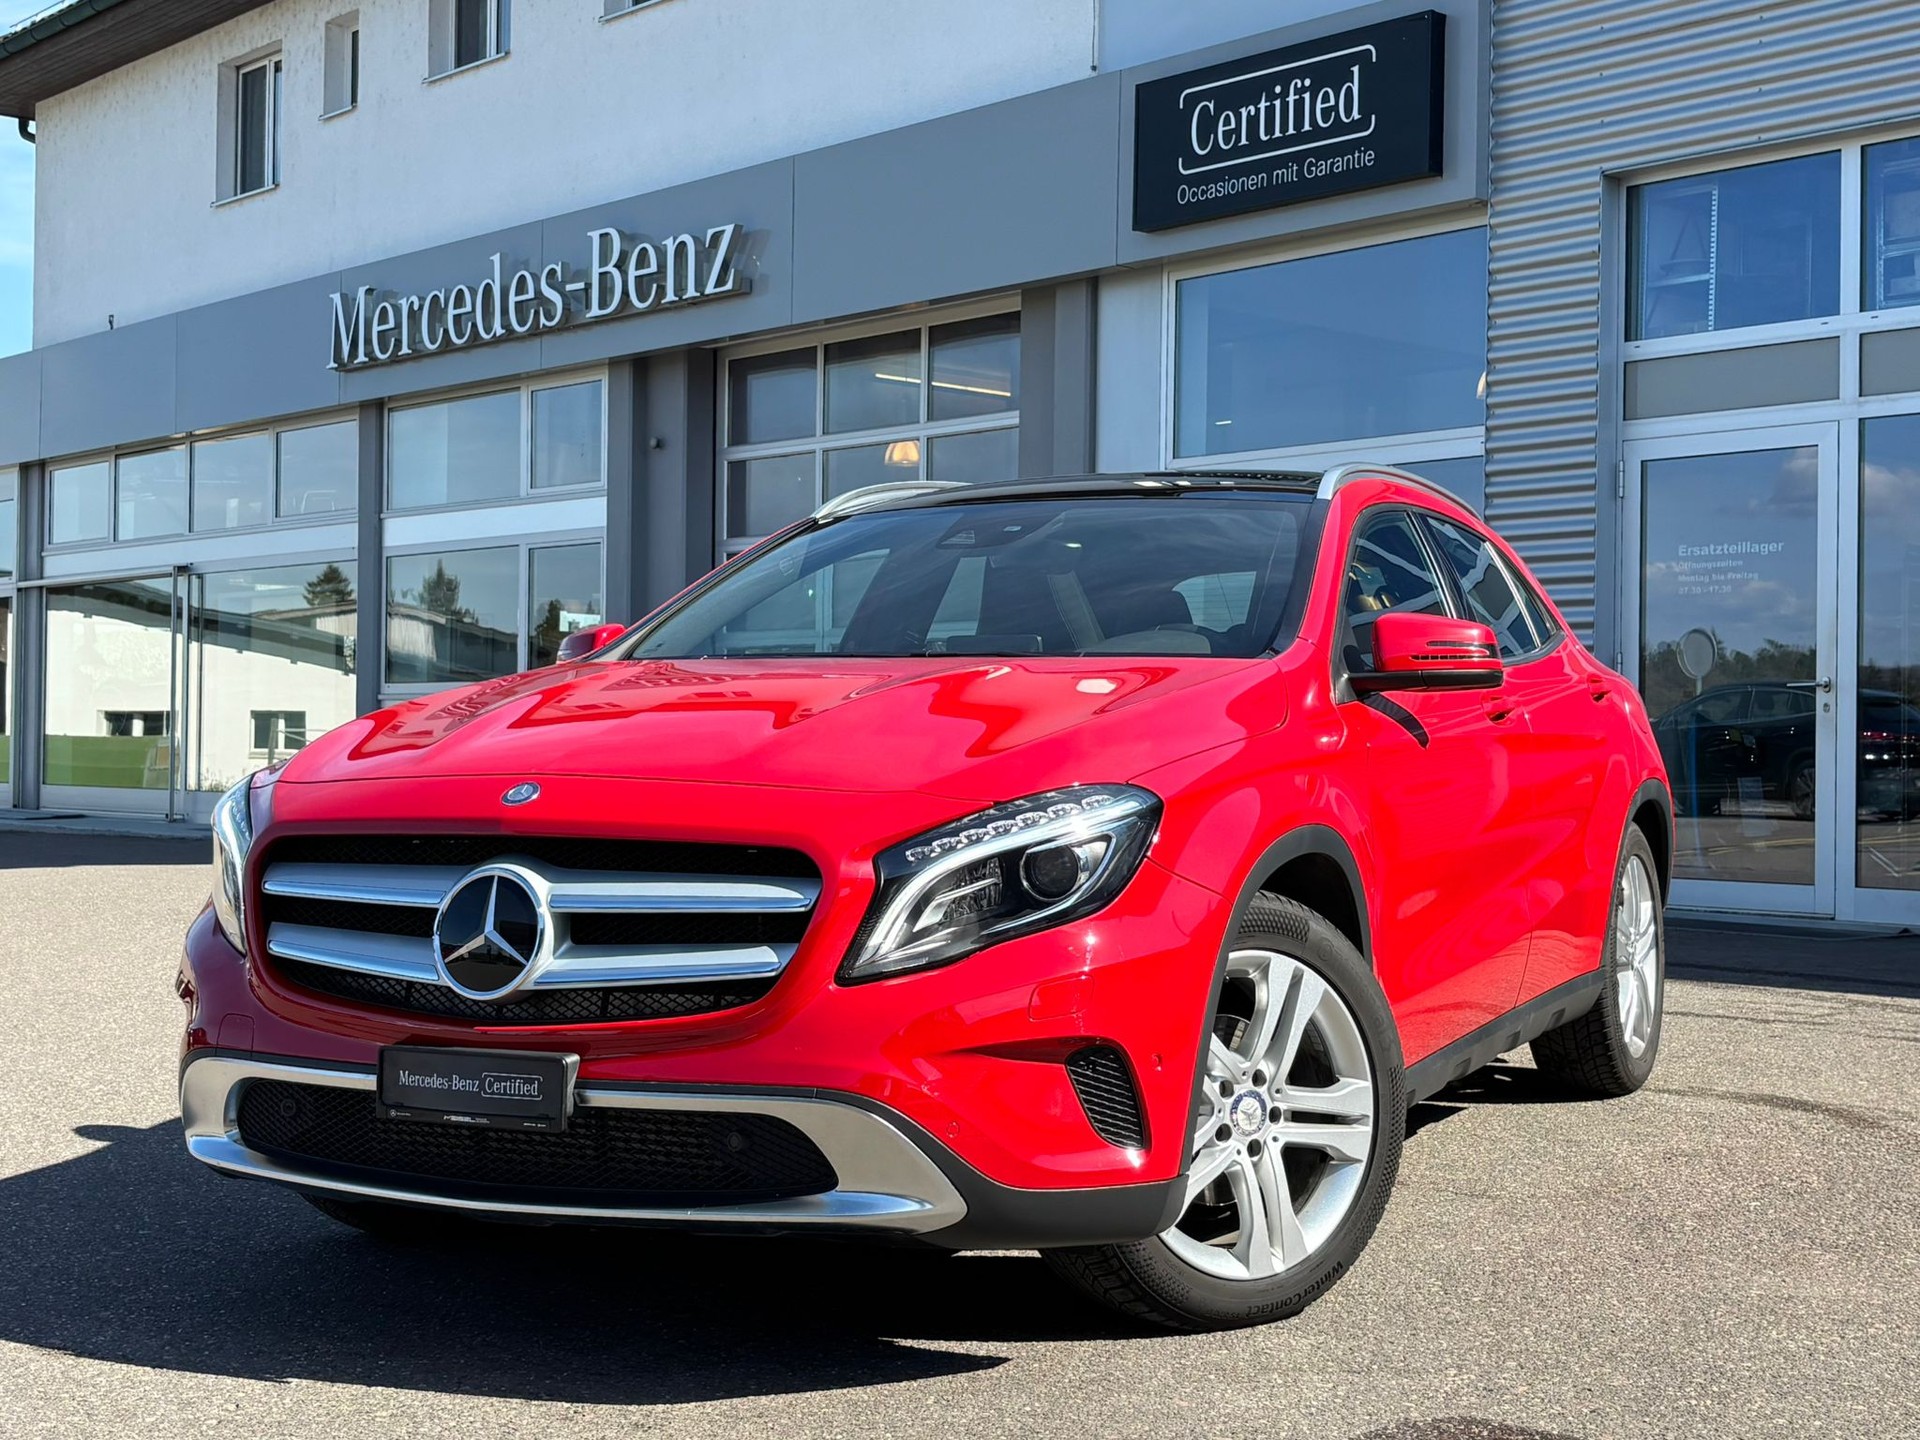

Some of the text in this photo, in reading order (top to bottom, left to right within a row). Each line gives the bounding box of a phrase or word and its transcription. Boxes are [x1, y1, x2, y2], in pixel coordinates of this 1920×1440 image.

[1190, 65, 1361, 155] Certified
[1177, 147, 1375, 205] Occasionen mit Garantie
[326, 223, 740, 370] Mercedes-Benz
[1678, 541, 1785, 556] Ersatzteillager
[399, 1070, 538, 1096] Mercedes-Benz Certified
[1245, 1260, 1344, 1317] WinterContact
